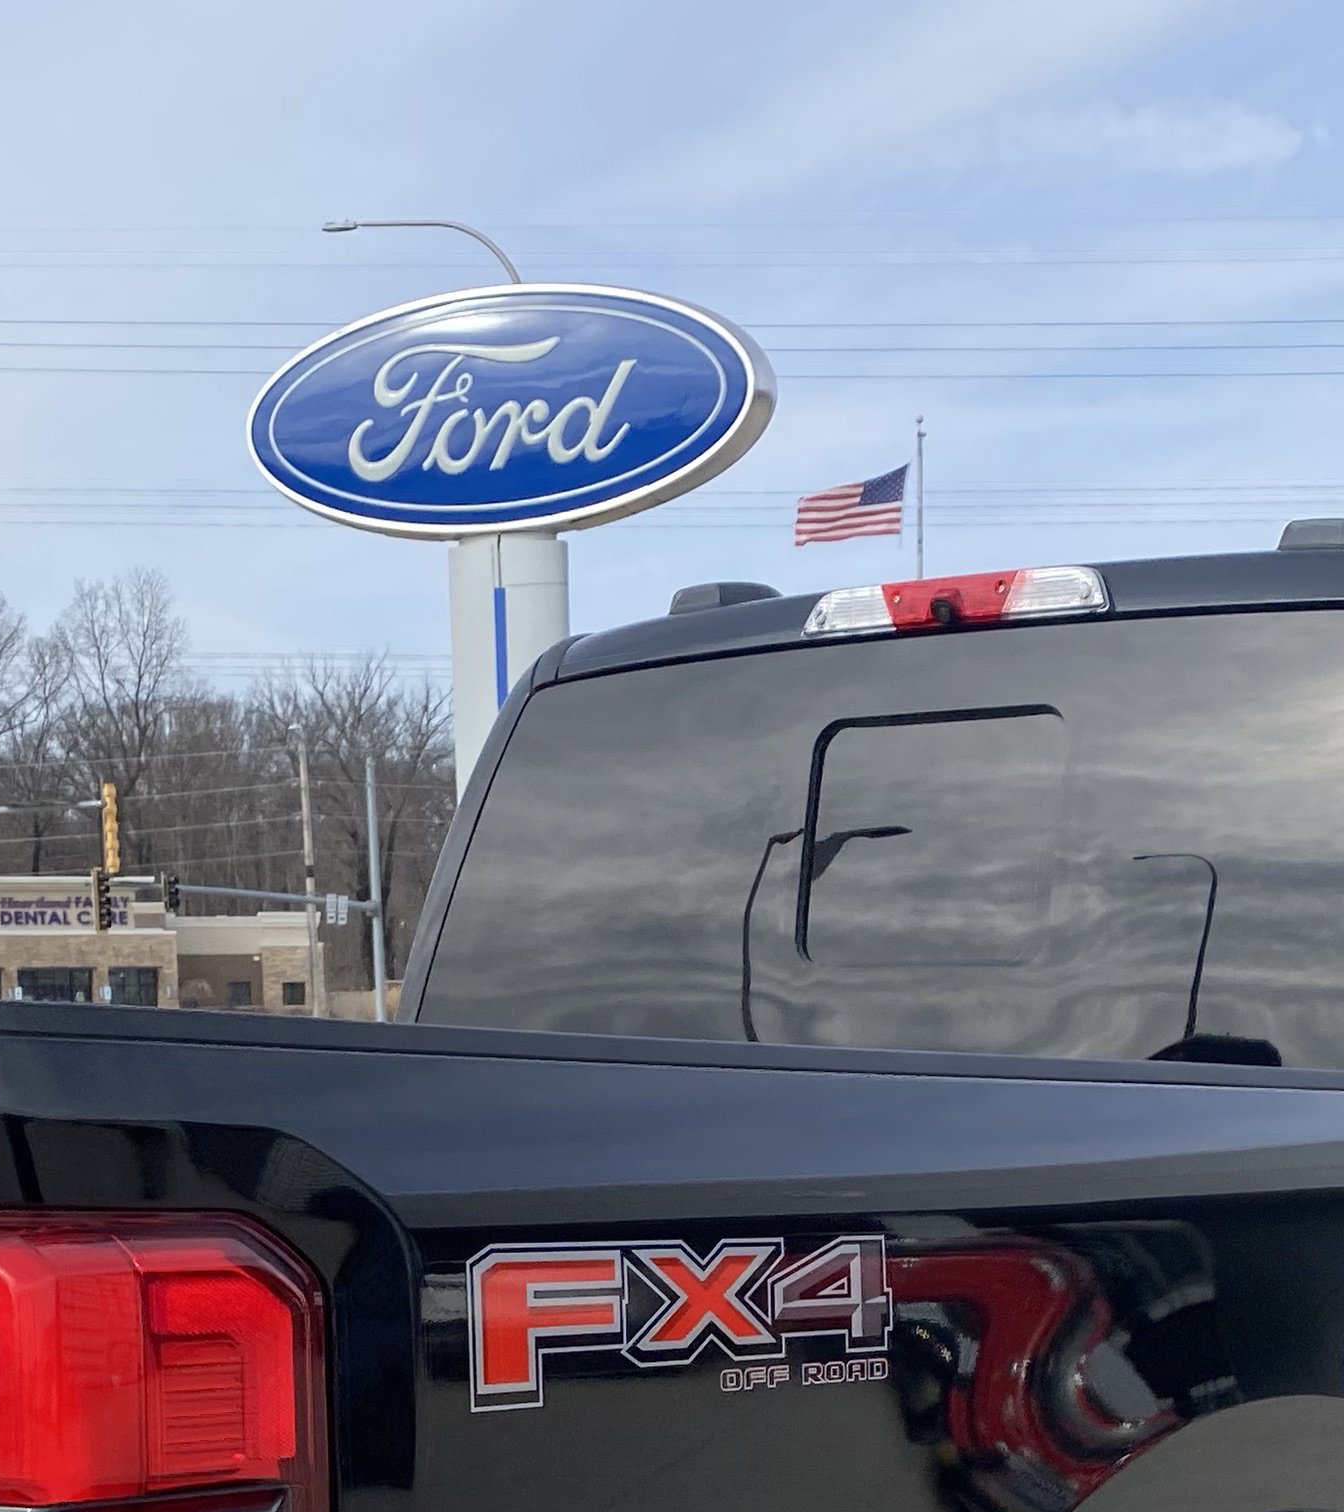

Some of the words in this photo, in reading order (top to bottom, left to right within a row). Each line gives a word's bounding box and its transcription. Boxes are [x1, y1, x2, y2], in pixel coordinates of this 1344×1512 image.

[348, 336, 637, 482] Ford
[0, 911, 71, 925] DENTAL
[77, 911, 128, 925] CRE
[75, 896, 129, 908] FALY
[466, 1235, 893, 1412] FX4
[719, 1364, 791, 1392] OFF
[802, 1356, 889, 1385] ROAD
